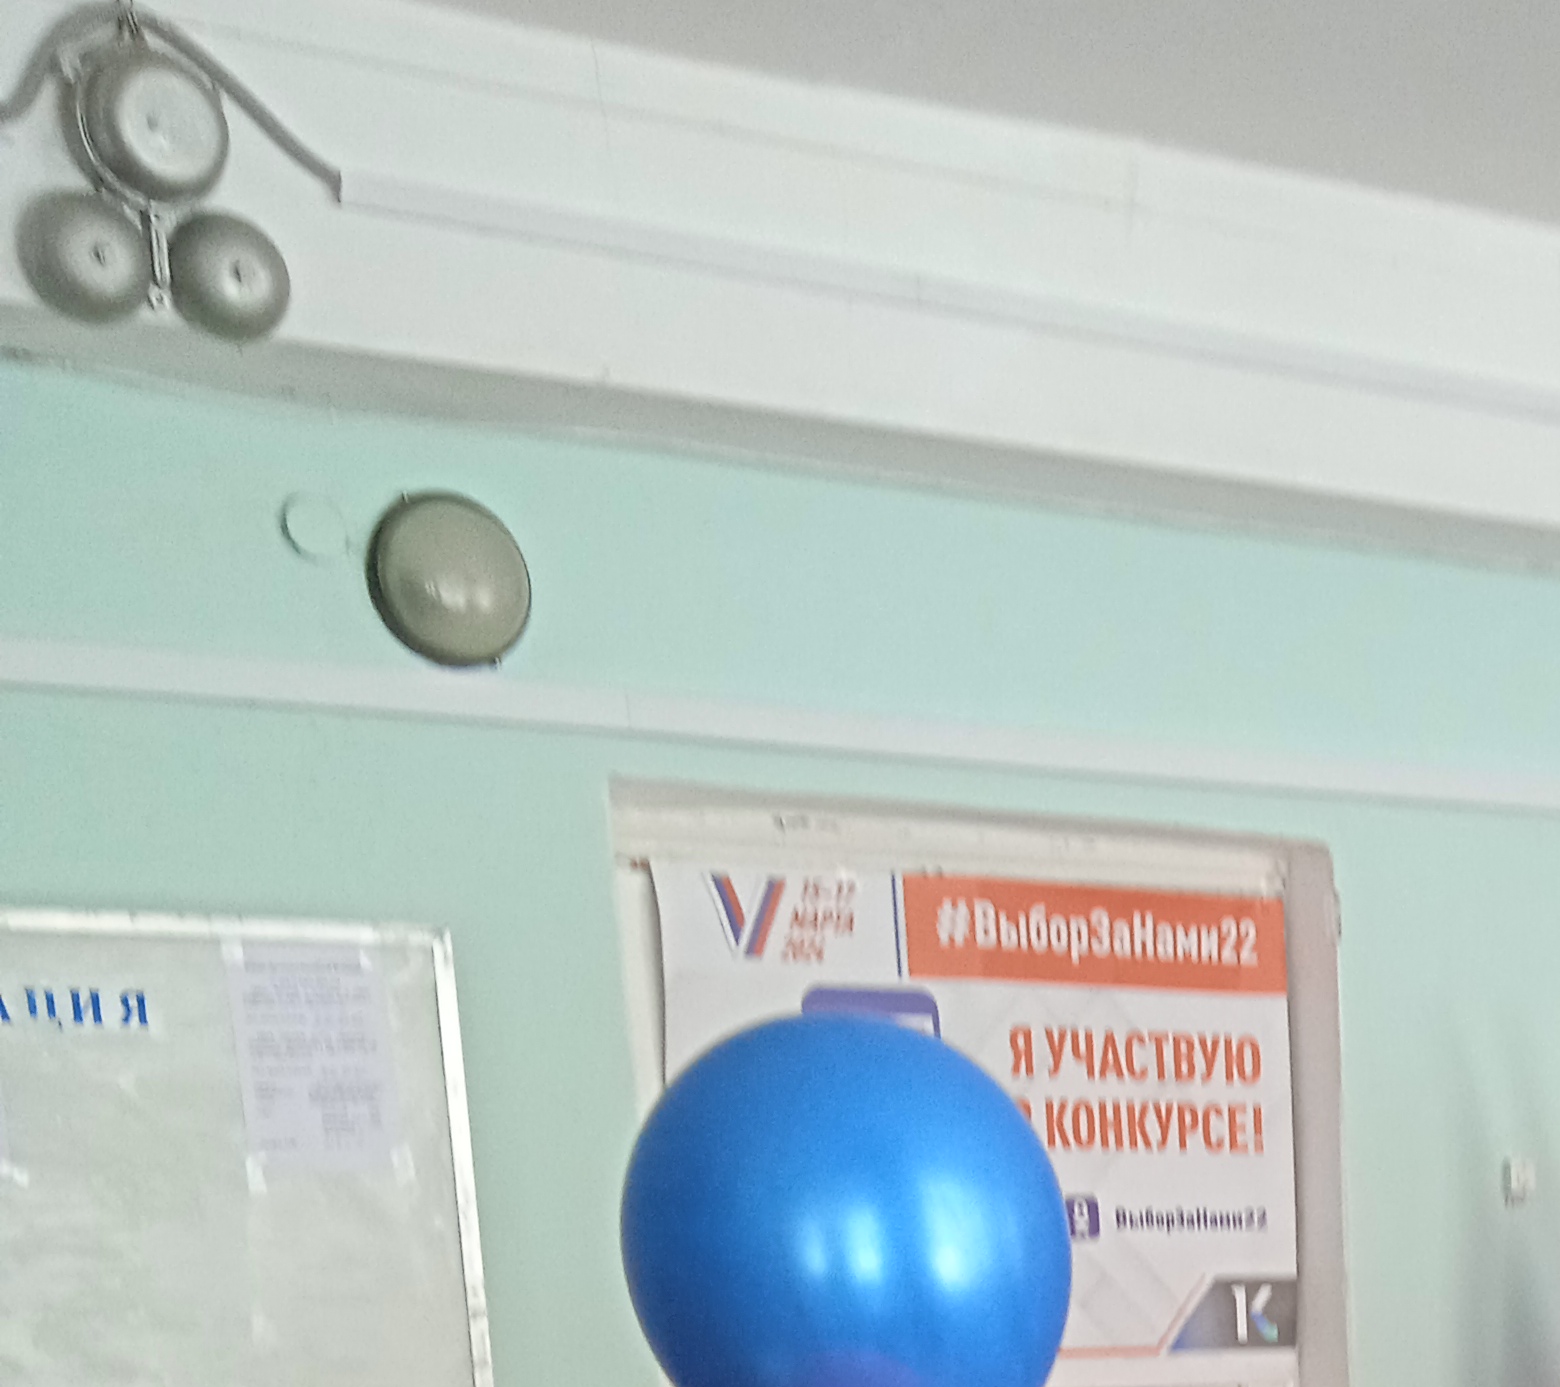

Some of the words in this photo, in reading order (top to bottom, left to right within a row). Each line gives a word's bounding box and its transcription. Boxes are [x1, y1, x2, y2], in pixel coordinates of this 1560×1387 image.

[936, 897, 1260, 968] #ВыборЗаНами22
[1008, 1022, 1036, 1080] Я
[1044, 1024, 1263, 1087] УЧАСТВУЮ
[1044, 1097, 1265, 1157] КОНКУРСЕ!
